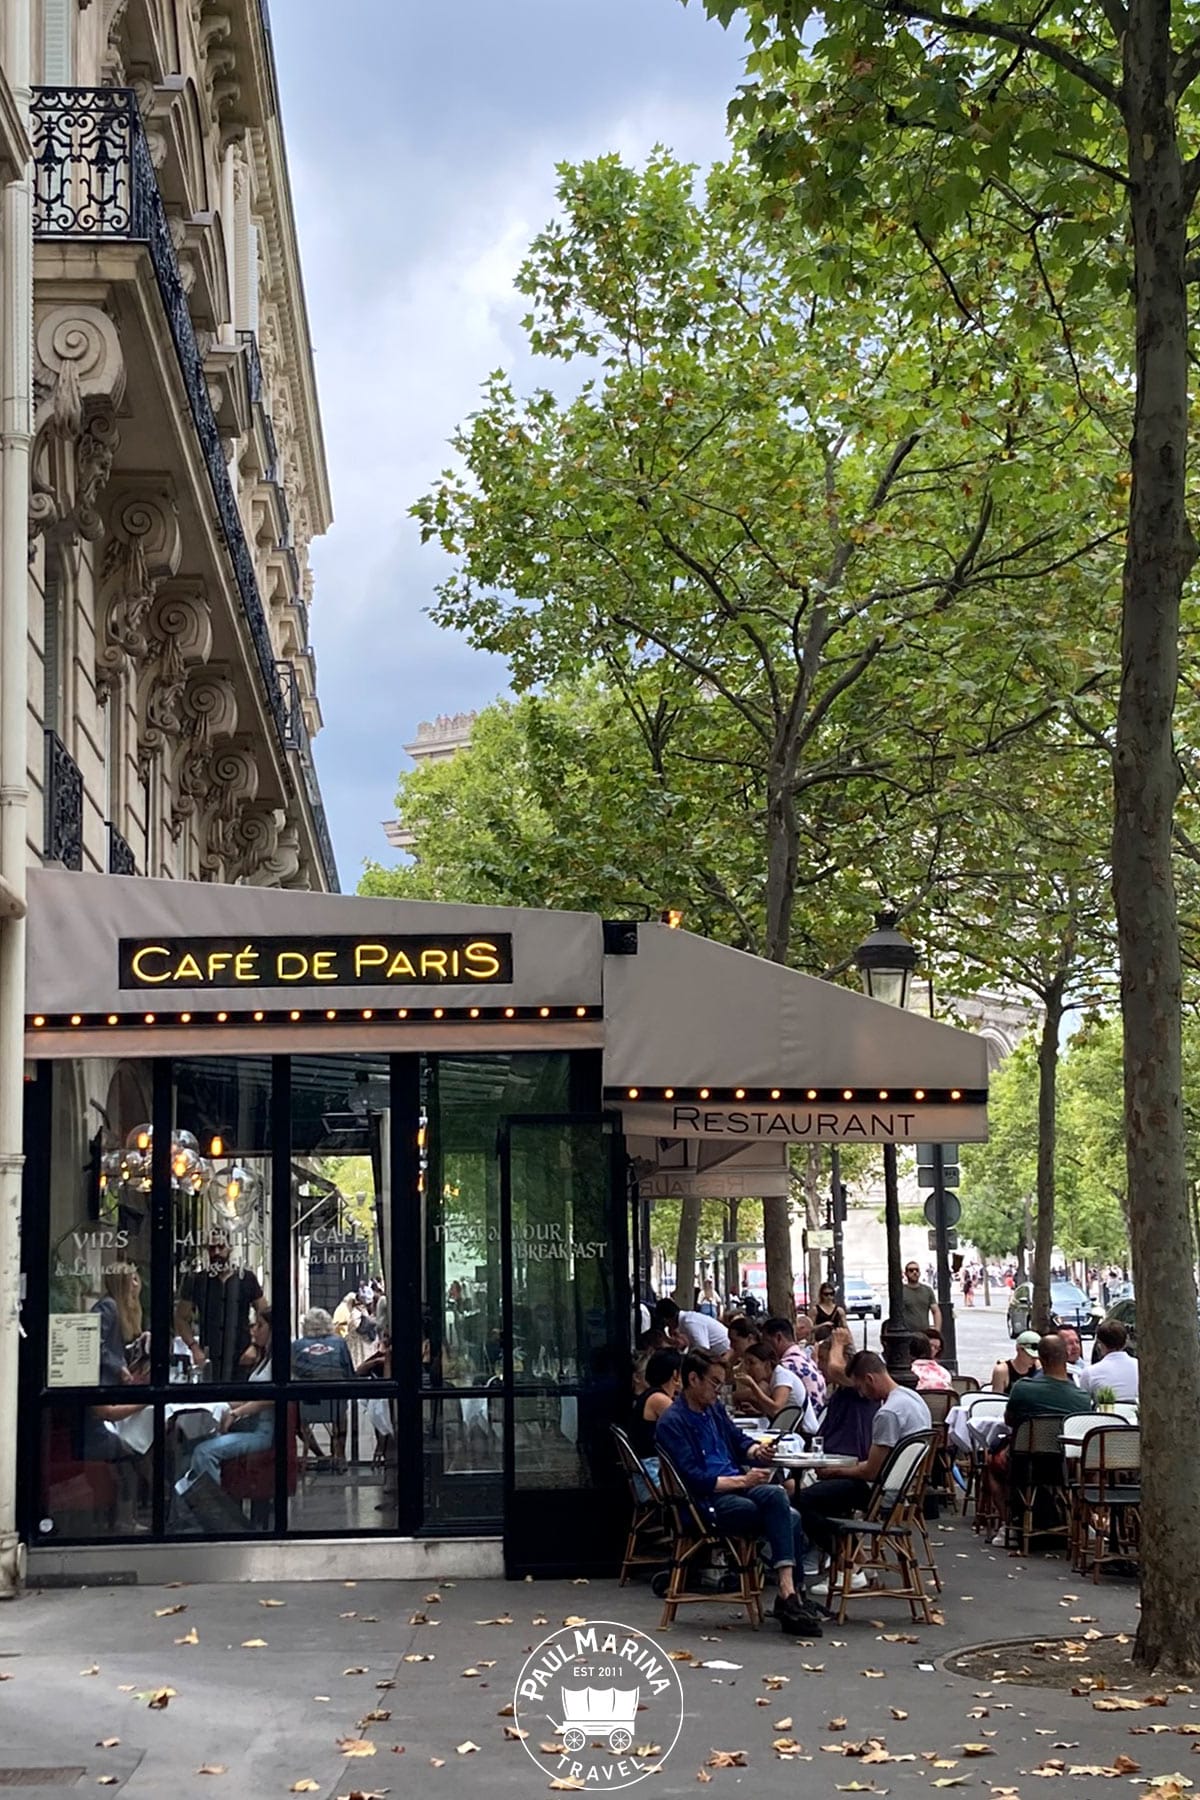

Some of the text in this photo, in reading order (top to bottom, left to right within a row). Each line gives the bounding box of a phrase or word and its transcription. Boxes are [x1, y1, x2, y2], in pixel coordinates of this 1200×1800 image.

[131, 941, 501, 983] CAFÉ DE PARIS
[673, 1106, 915, 1136] RESTAURANT
[73, 1230, 129, 1249] VINS
